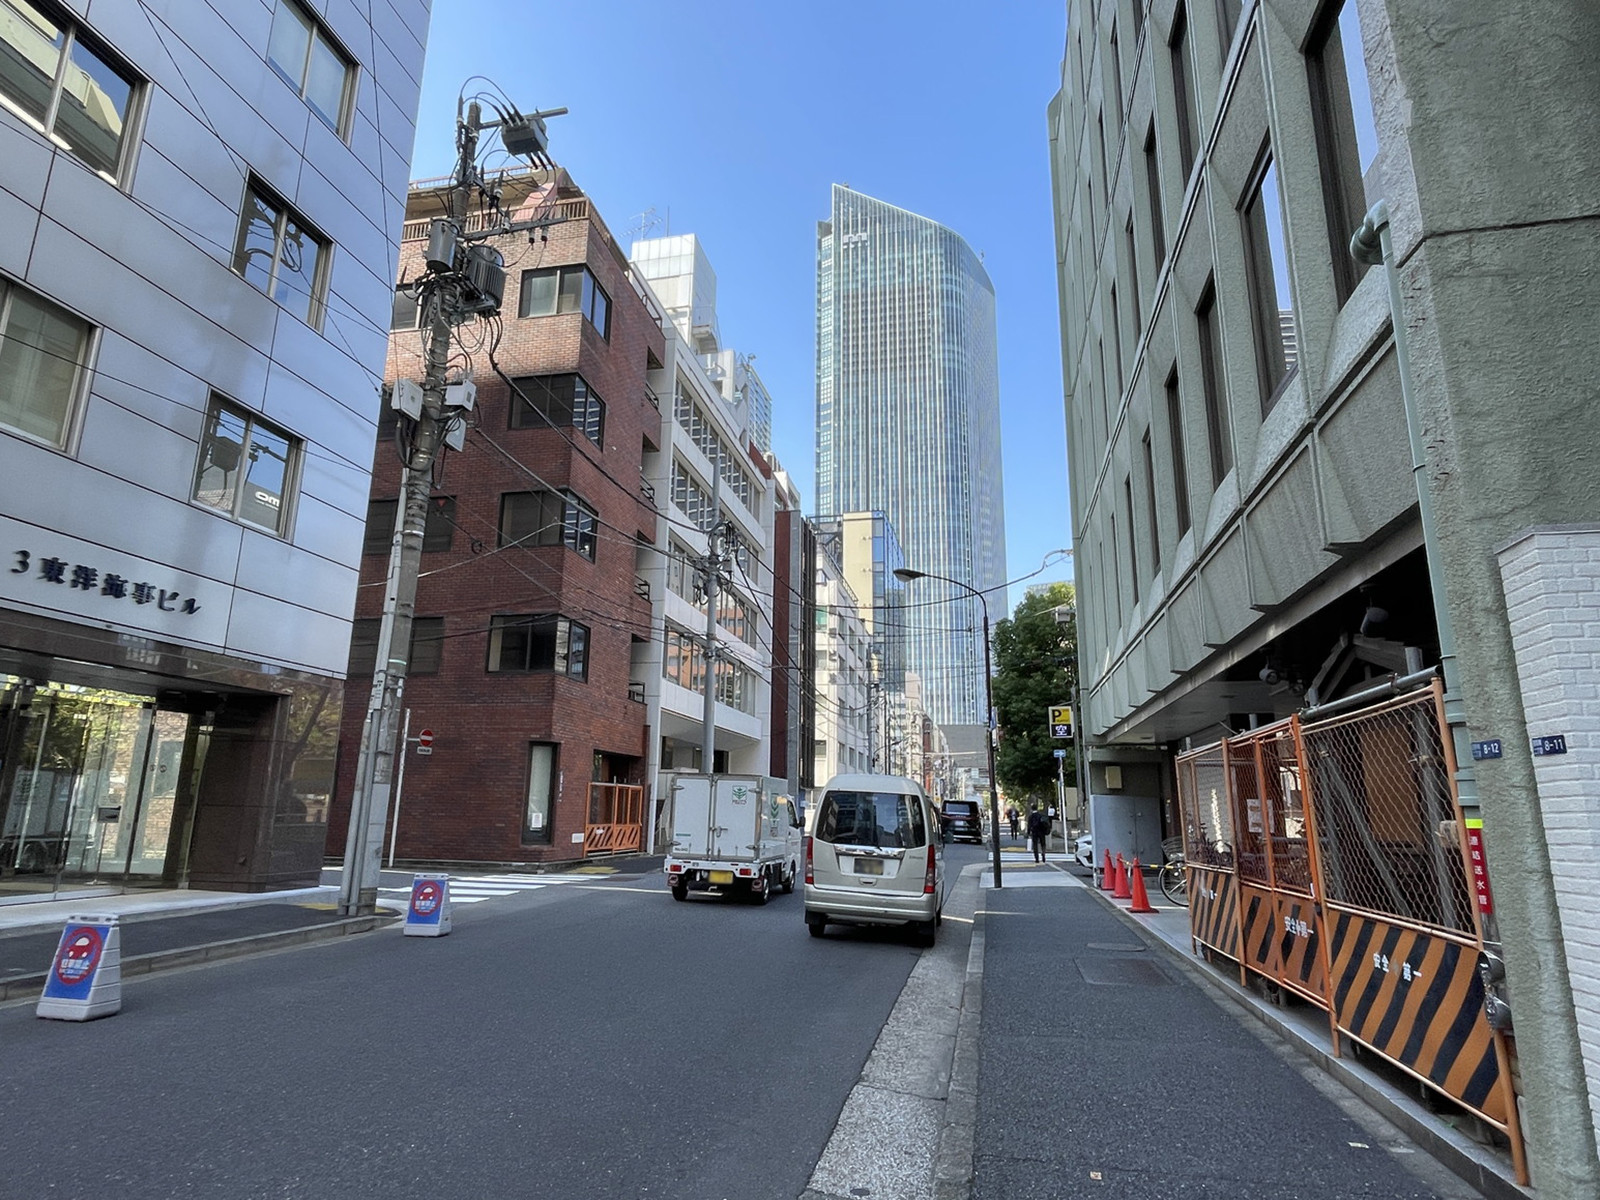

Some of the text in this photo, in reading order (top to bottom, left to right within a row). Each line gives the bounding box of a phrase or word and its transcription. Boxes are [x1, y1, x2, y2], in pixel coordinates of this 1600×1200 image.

[1052, 709, 1062, 723] P
[1483, 742, 1499, 754] 8-12
[1544, 739, 1564, 751] 8-11
